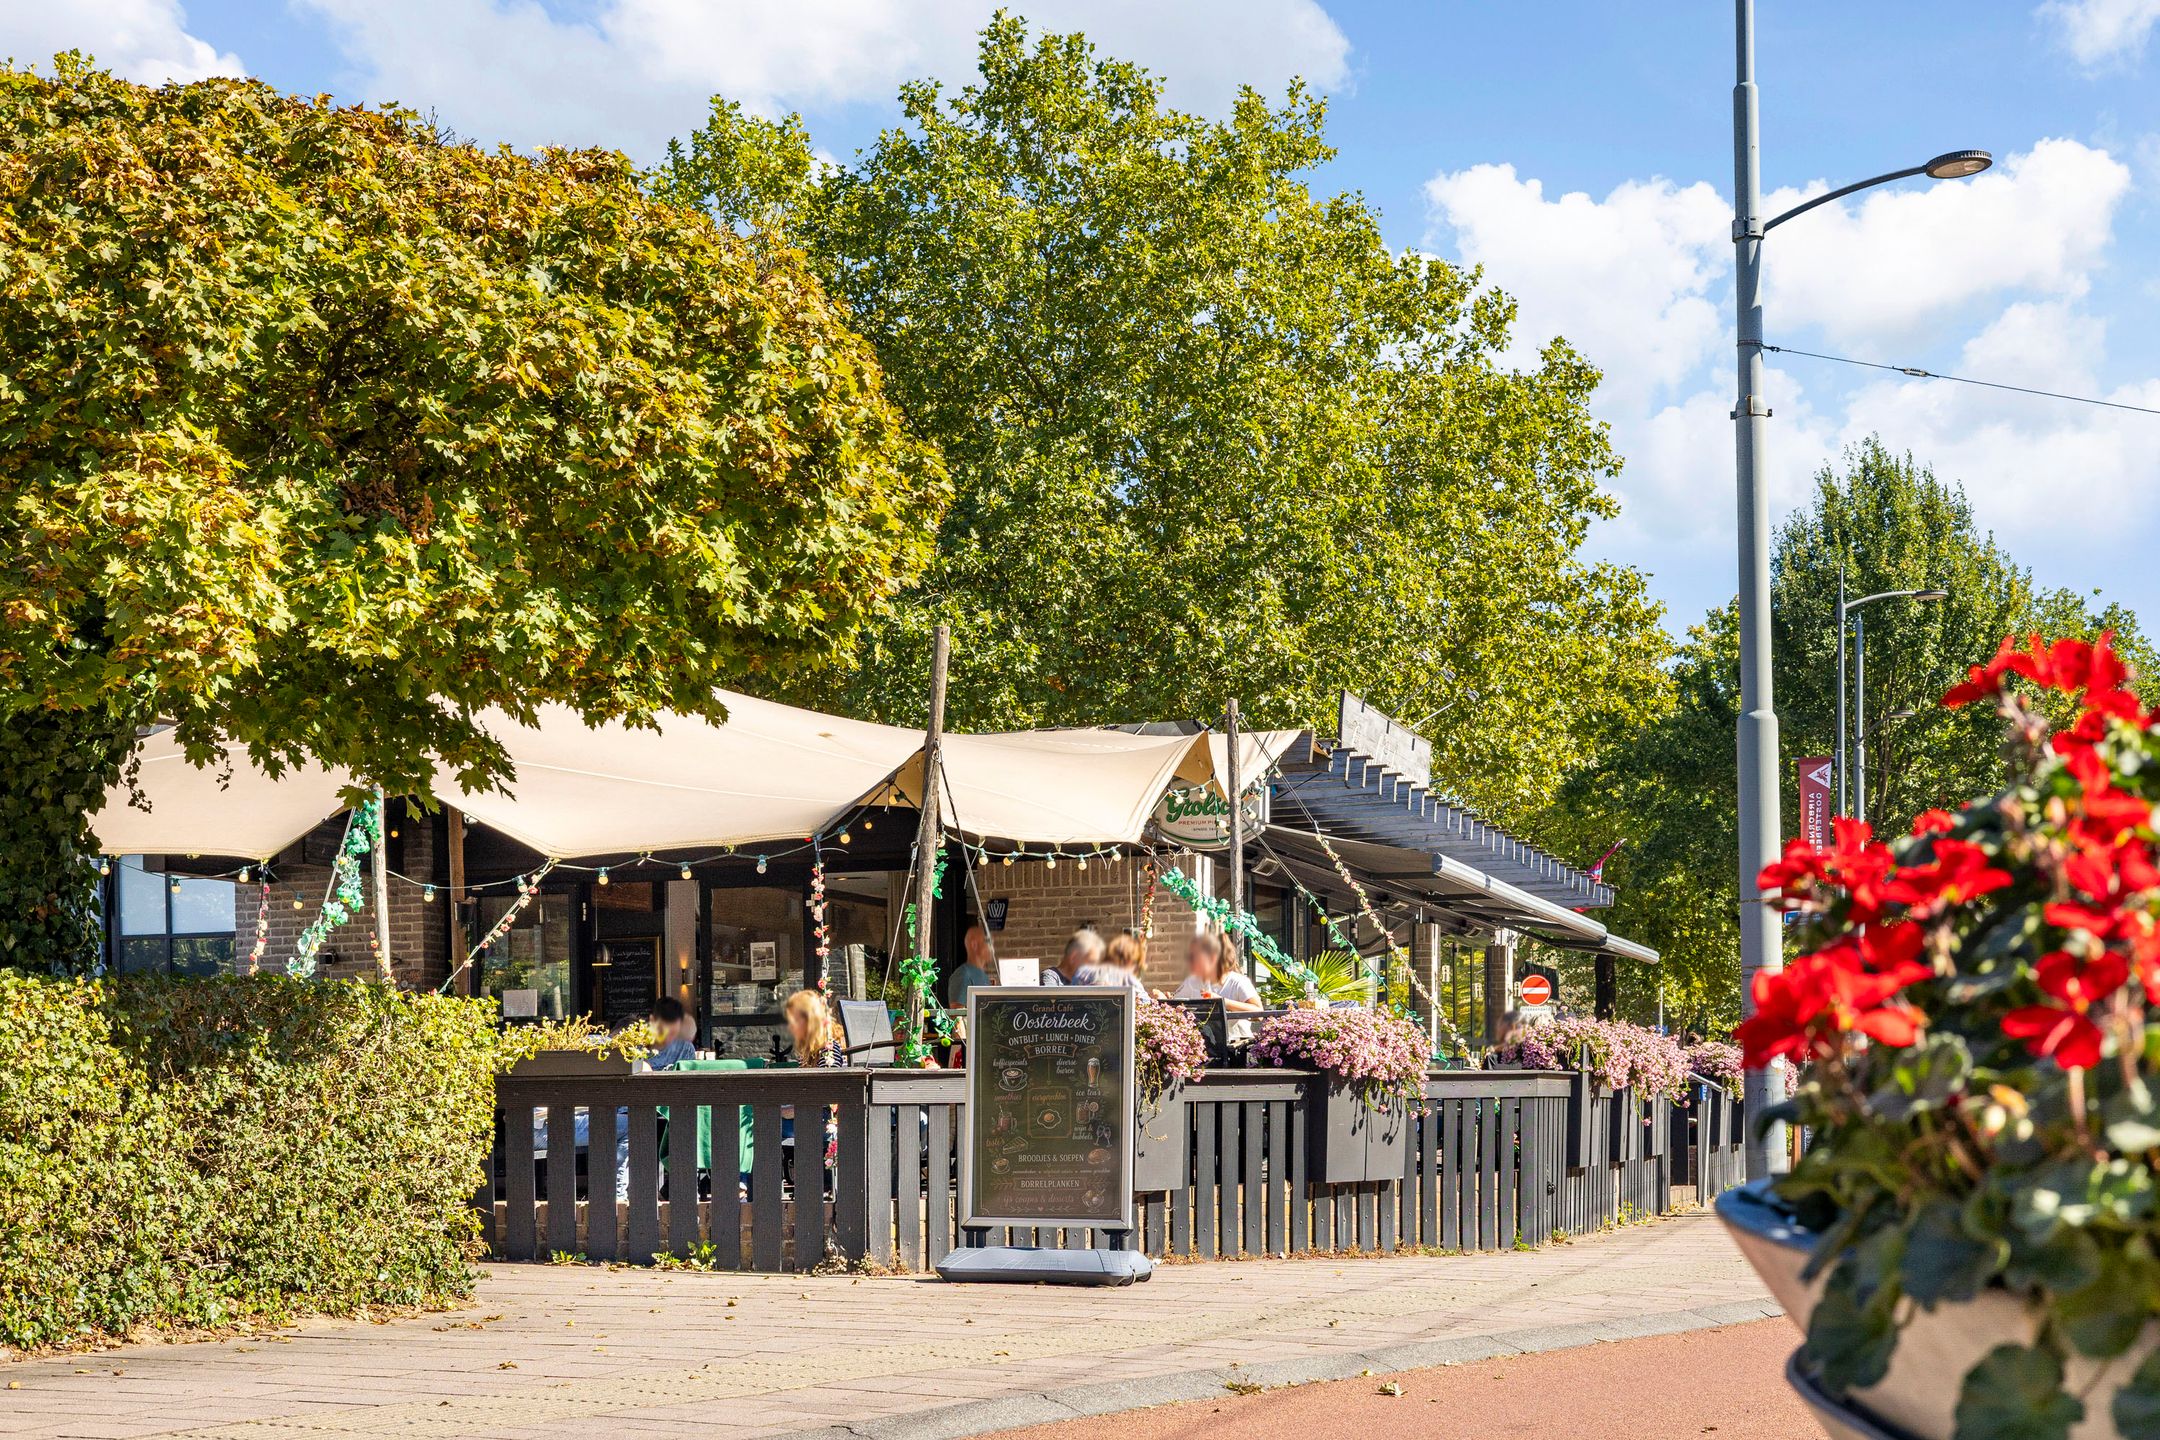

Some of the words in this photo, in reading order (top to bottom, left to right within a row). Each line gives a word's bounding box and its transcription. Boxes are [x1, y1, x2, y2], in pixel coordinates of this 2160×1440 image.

[1032, 1004, 1055, 1012] Grand
[1056, 1003, 1074, 1012] Café
[1013, 1011, 1096, 1031] Oosterbeek
[1008, 1034, 1039, 1046] ONTBIJT
[1045, 1033, 1069, 1042] LUNCH
[1074, 1035, 1096, 1045] DINER
[1035, 1045, 1067, 1055] BORREL
[1018, 1154, 1051, 1162] BROODJES
[1053, 1154, 1058, 1162] &
[1059, 1154, 1084, 1162] SOEPEN
[1021, 1180, 1080, 1188] BORRELPLANKEN
